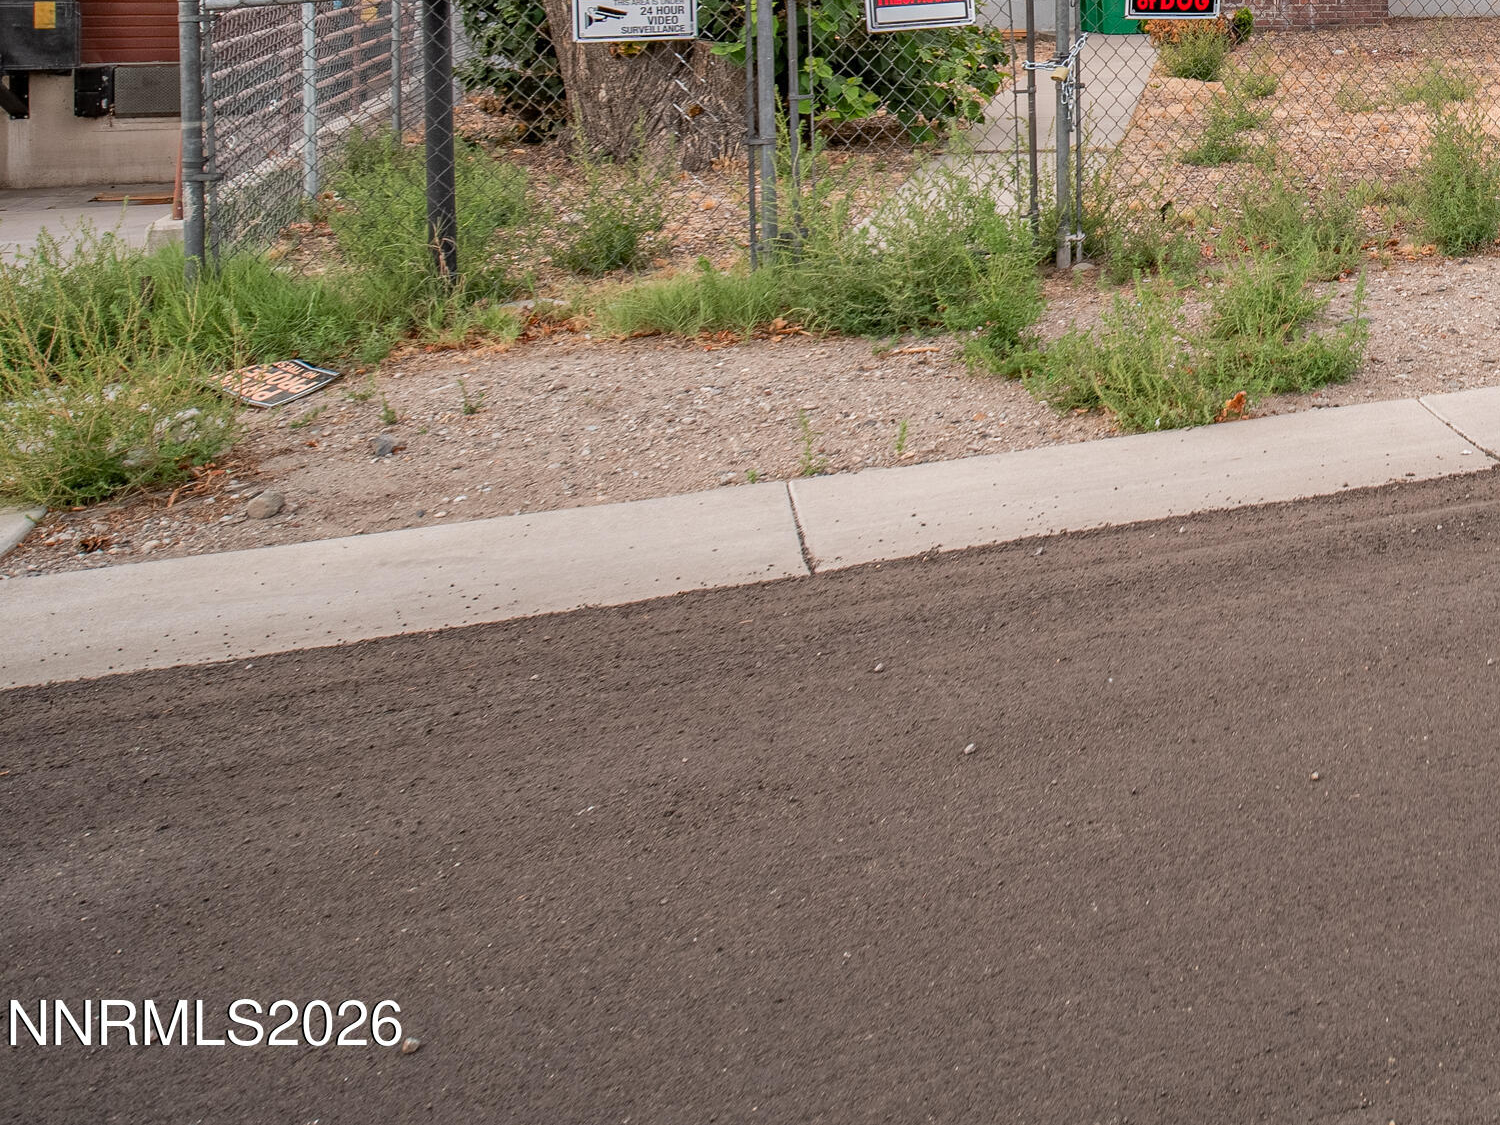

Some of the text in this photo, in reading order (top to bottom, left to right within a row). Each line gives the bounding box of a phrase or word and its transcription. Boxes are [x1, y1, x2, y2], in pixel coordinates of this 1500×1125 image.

[640, 5, 685, 15] 24 HOUR
[647, 16, 679, 25] VIDEO
[620, 25, 685, 34] SURVEILLANCE
